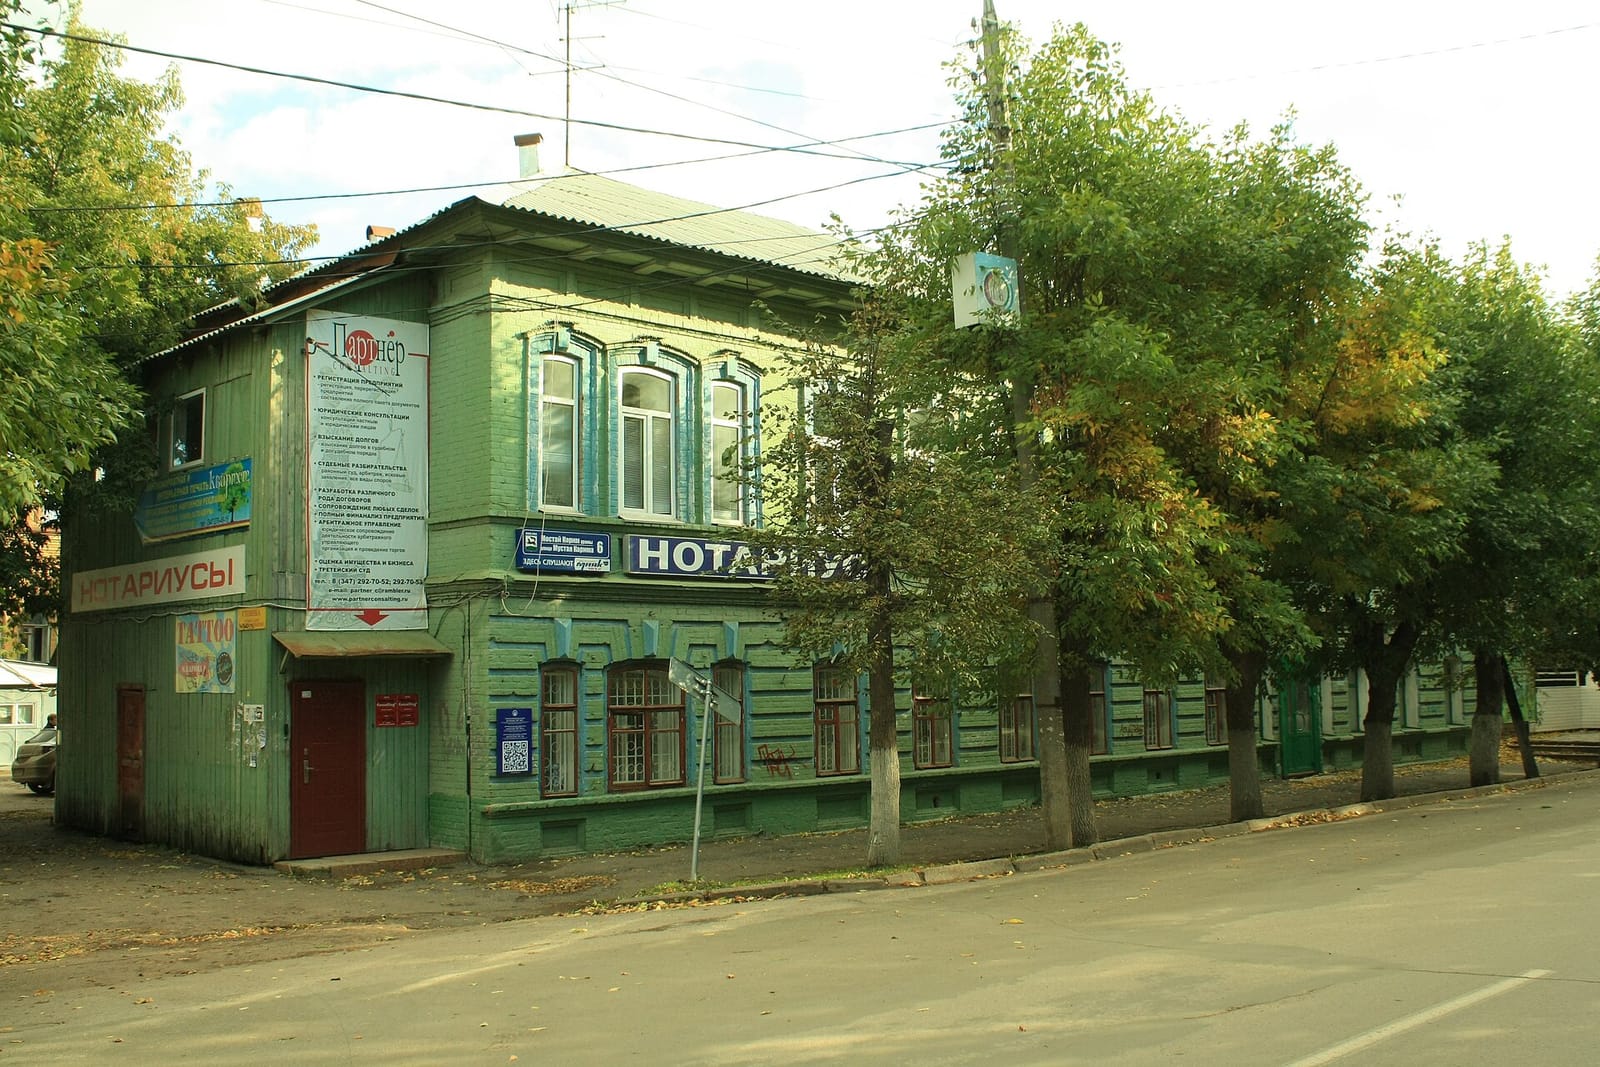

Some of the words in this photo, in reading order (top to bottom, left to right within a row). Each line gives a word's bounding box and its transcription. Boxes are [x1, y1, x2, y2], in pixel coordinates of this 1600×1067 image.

[332, 322, 405, 376] Партнёр
[318, 375, 360, 384] РЕГИСТРАЦИЯ
[318, 408, 362, 416] ЮРИДИЧЕСКИЕ
[364, 412, 410, 420] КОНСУЛЬТАЦИИ
[351, 463, 407, 471] РАЗБИРАТЕЛЬСТВА
[597, 541, 603, 554] 6
[80, 558, 233, 604] НОТАРИУСЫ
[177, 618, 234, 644] TATTOO
